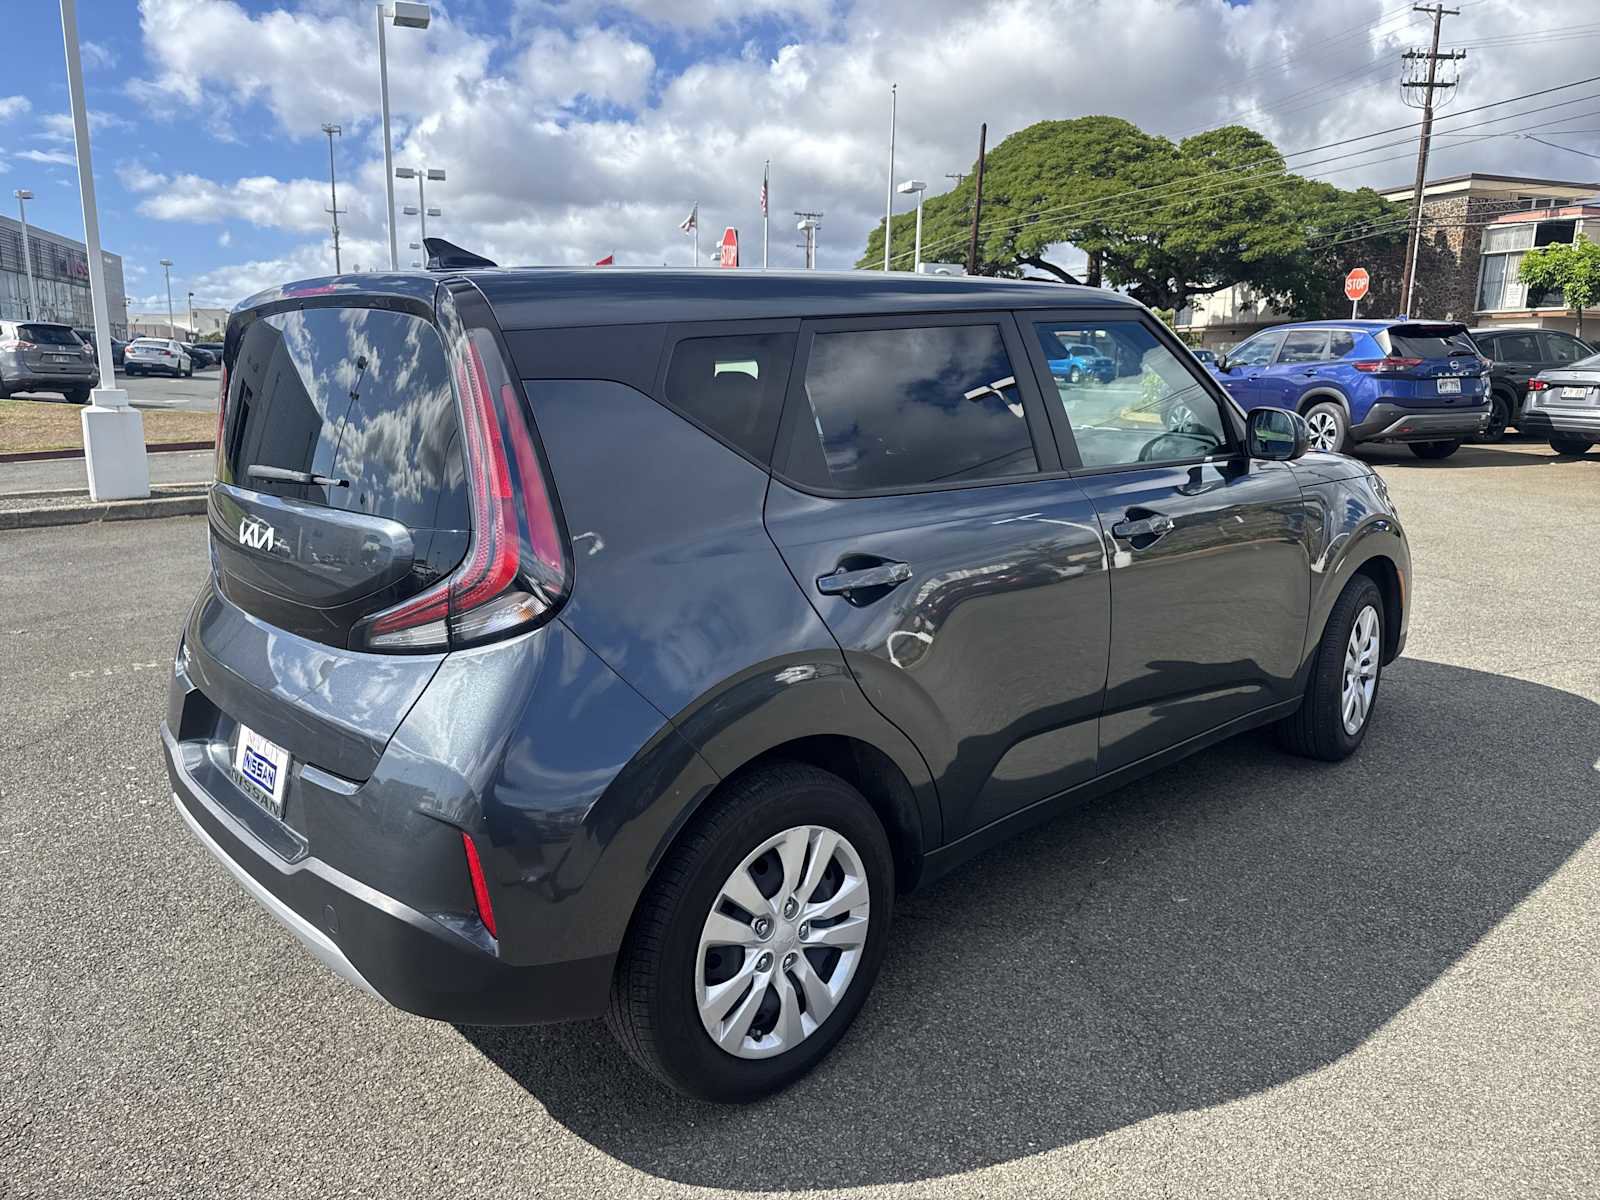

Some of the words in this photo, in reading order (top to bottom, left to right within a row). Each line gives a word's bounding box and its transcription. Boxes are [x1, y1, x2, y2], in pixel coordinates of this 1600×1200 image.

[1347, 278, 1367, 290] STOP
[239, 519, 274, 551] KIA
[243, 752, 275, 787] NISSAN
[231, 768, 281, 816] NISSAN
